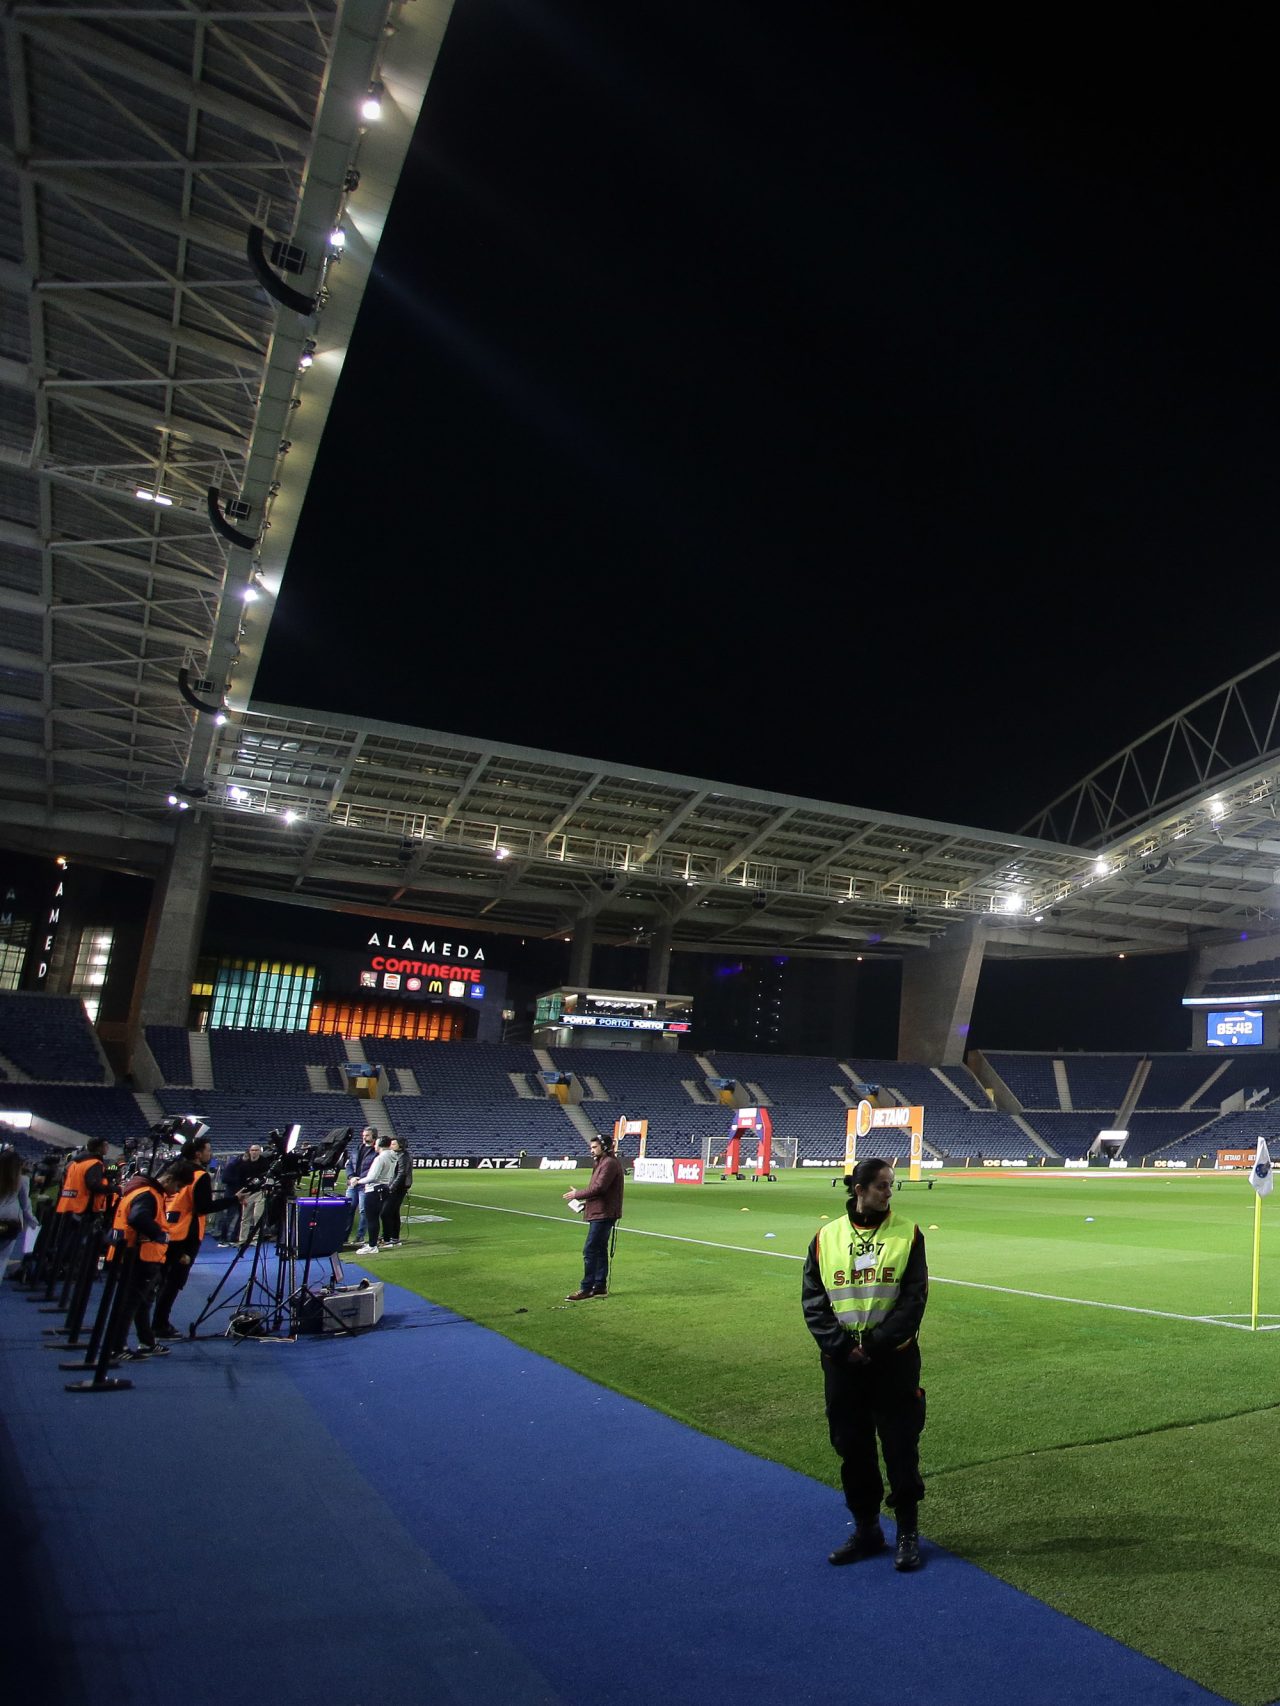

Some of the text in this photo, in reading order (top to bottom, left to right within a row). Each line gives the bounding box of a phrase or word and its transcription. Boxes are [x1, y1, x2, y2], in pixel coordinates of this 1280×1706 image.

[368, 933, 485, 961] ALAMEDA
[371, 956, 481, 982] CONTINENTE
[872, 1108, 910, 1125] BETANO
[539, 1156, 578, 1170] bwin
[848, 1243, 885, 1256] 1397
